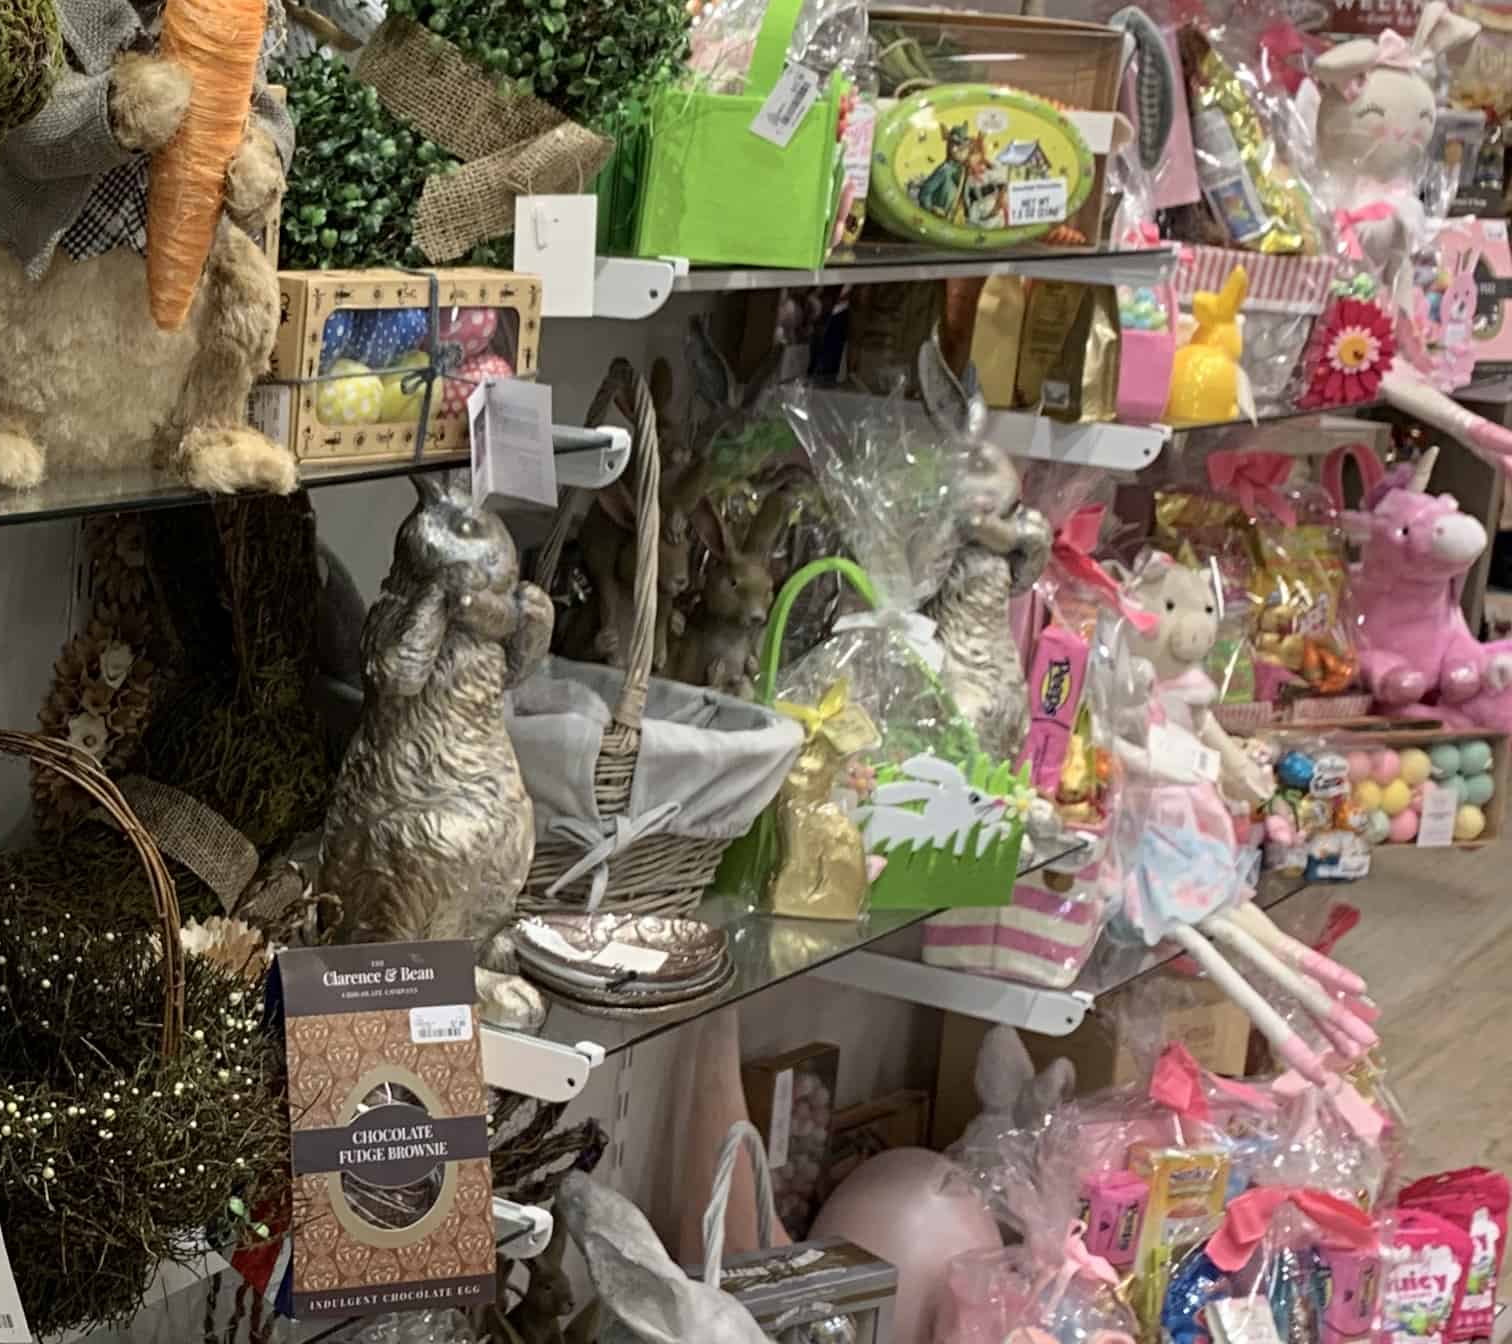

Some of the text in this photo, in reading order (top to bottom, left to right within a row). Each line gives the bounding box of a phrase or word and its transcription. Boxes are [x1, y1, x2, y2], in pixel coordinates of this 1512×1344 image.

[1045, 656, 1071, 716] Peeps
[322, 967, 435, 987] Clarence & Bean
[351, 1124, 434, 1145] CHOCOLATE
[339, 1141, 449, 1165] FUDGE BROWNIE
[309, 1284, 481, 1312] INDULGENT CHOCOLATE EGG
